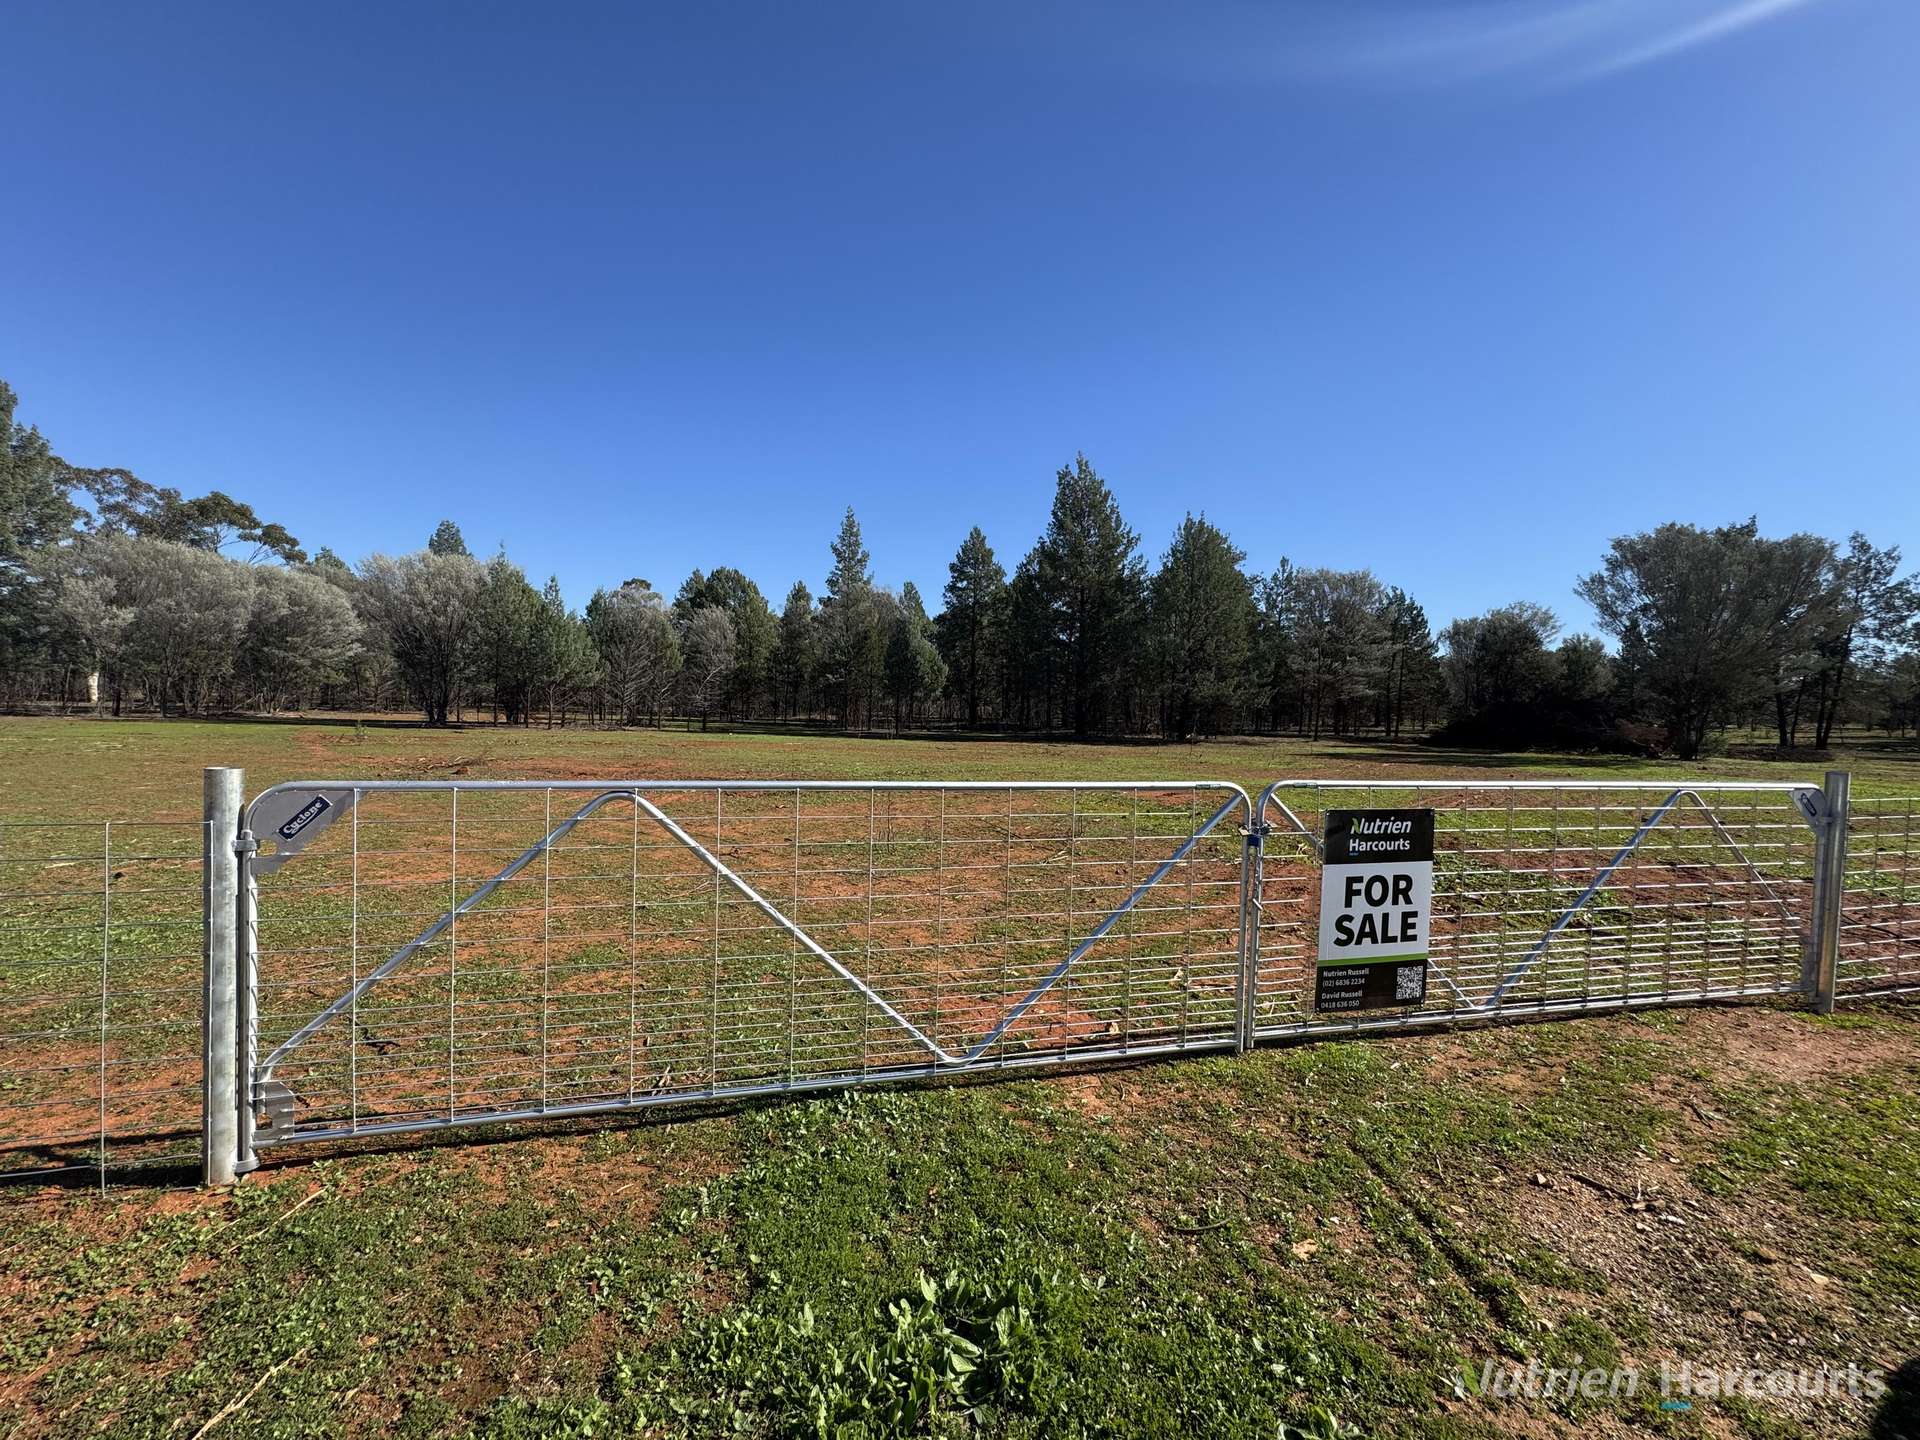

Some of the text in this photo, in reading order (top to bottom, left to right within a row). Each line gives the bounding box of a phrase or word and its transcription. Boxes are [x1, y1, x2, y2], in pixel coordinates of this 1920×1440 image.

[283, 801, 323, 834] Cyclone
[1350, 816, 1412, 834] Nutrien
[1349, 839, 1411, 851] Harcourts
[1344, 874, 1413, 908] FOR
[1333, 911, 1418, 947] SALE
[1323, 967, 1369, 977] Nutrien Russell
[1322, 979, 1335, 988] (02)
[1350, 977, 1365, 985] 2234
[1321, 989, 1363, 1000] David Russell
[1320, 1001, 1336, 1009] 0418
[1348, 999, 1360, 1007] 050
